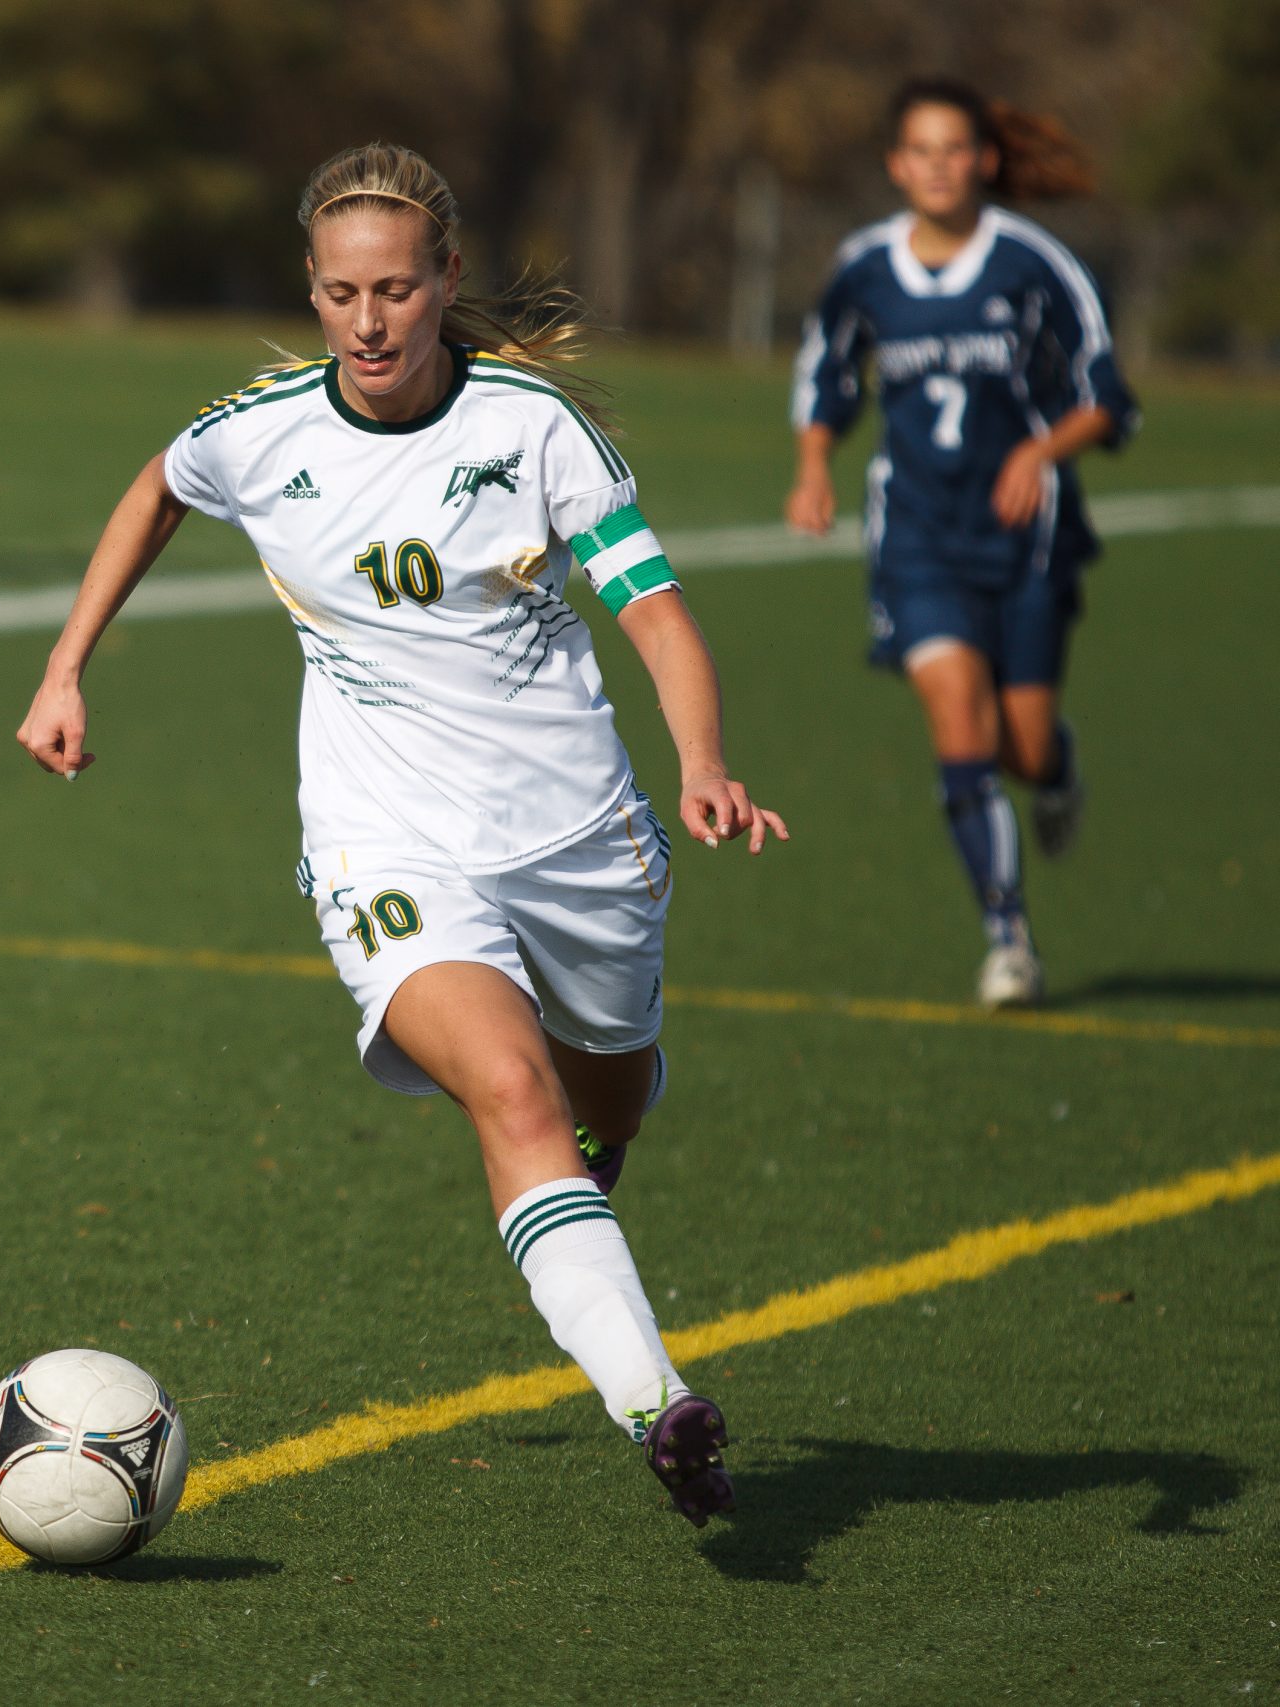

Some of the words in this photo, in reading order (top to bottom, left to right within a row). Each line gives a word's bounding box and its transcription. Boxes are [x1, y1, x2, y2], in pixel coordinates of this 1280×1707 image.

[924, 375, 967, 449] 7
[283, 488, 321, 499] adidas
[354, 538, 444, 609] 10
[346, 889, 423, 962] 10
